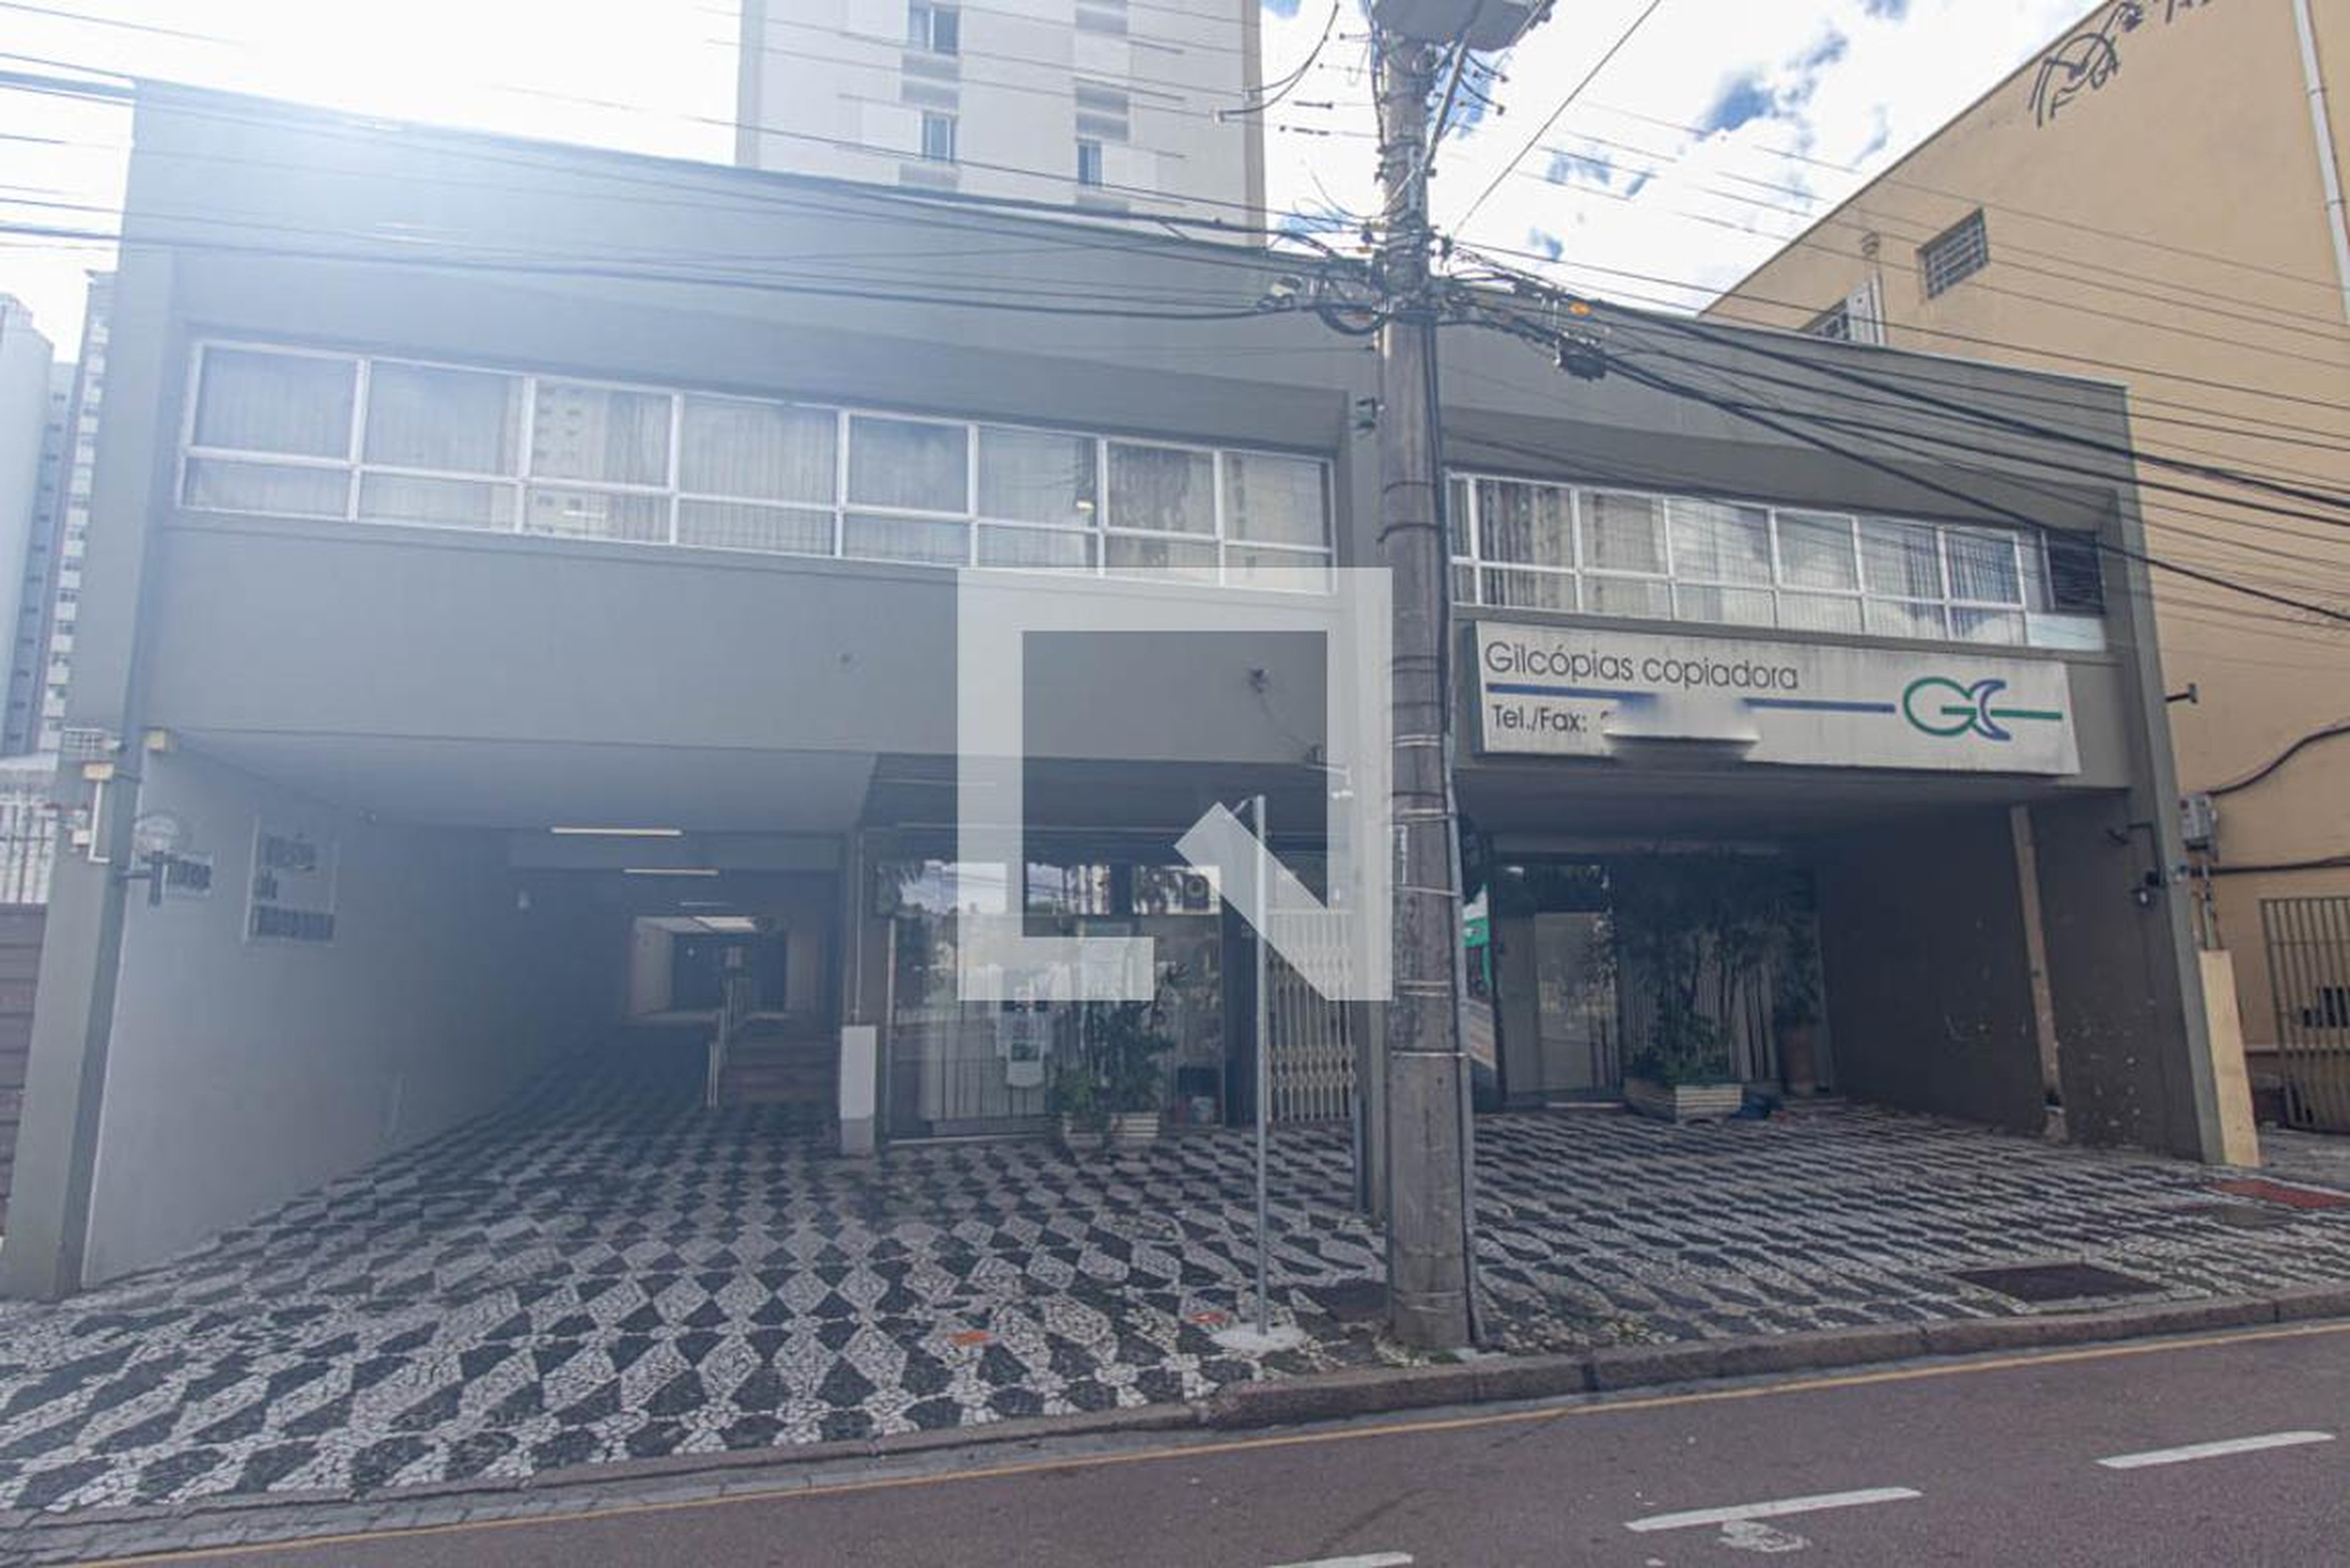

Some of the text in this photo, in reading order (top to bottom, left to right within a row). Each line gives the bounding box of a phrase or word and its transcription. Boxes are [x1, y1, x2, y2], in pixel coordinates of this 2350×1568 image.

[1485, 641, 1798, 690] Gilcópias copiadora
[1493, 704, 1588, 733] Tel./Fax:
